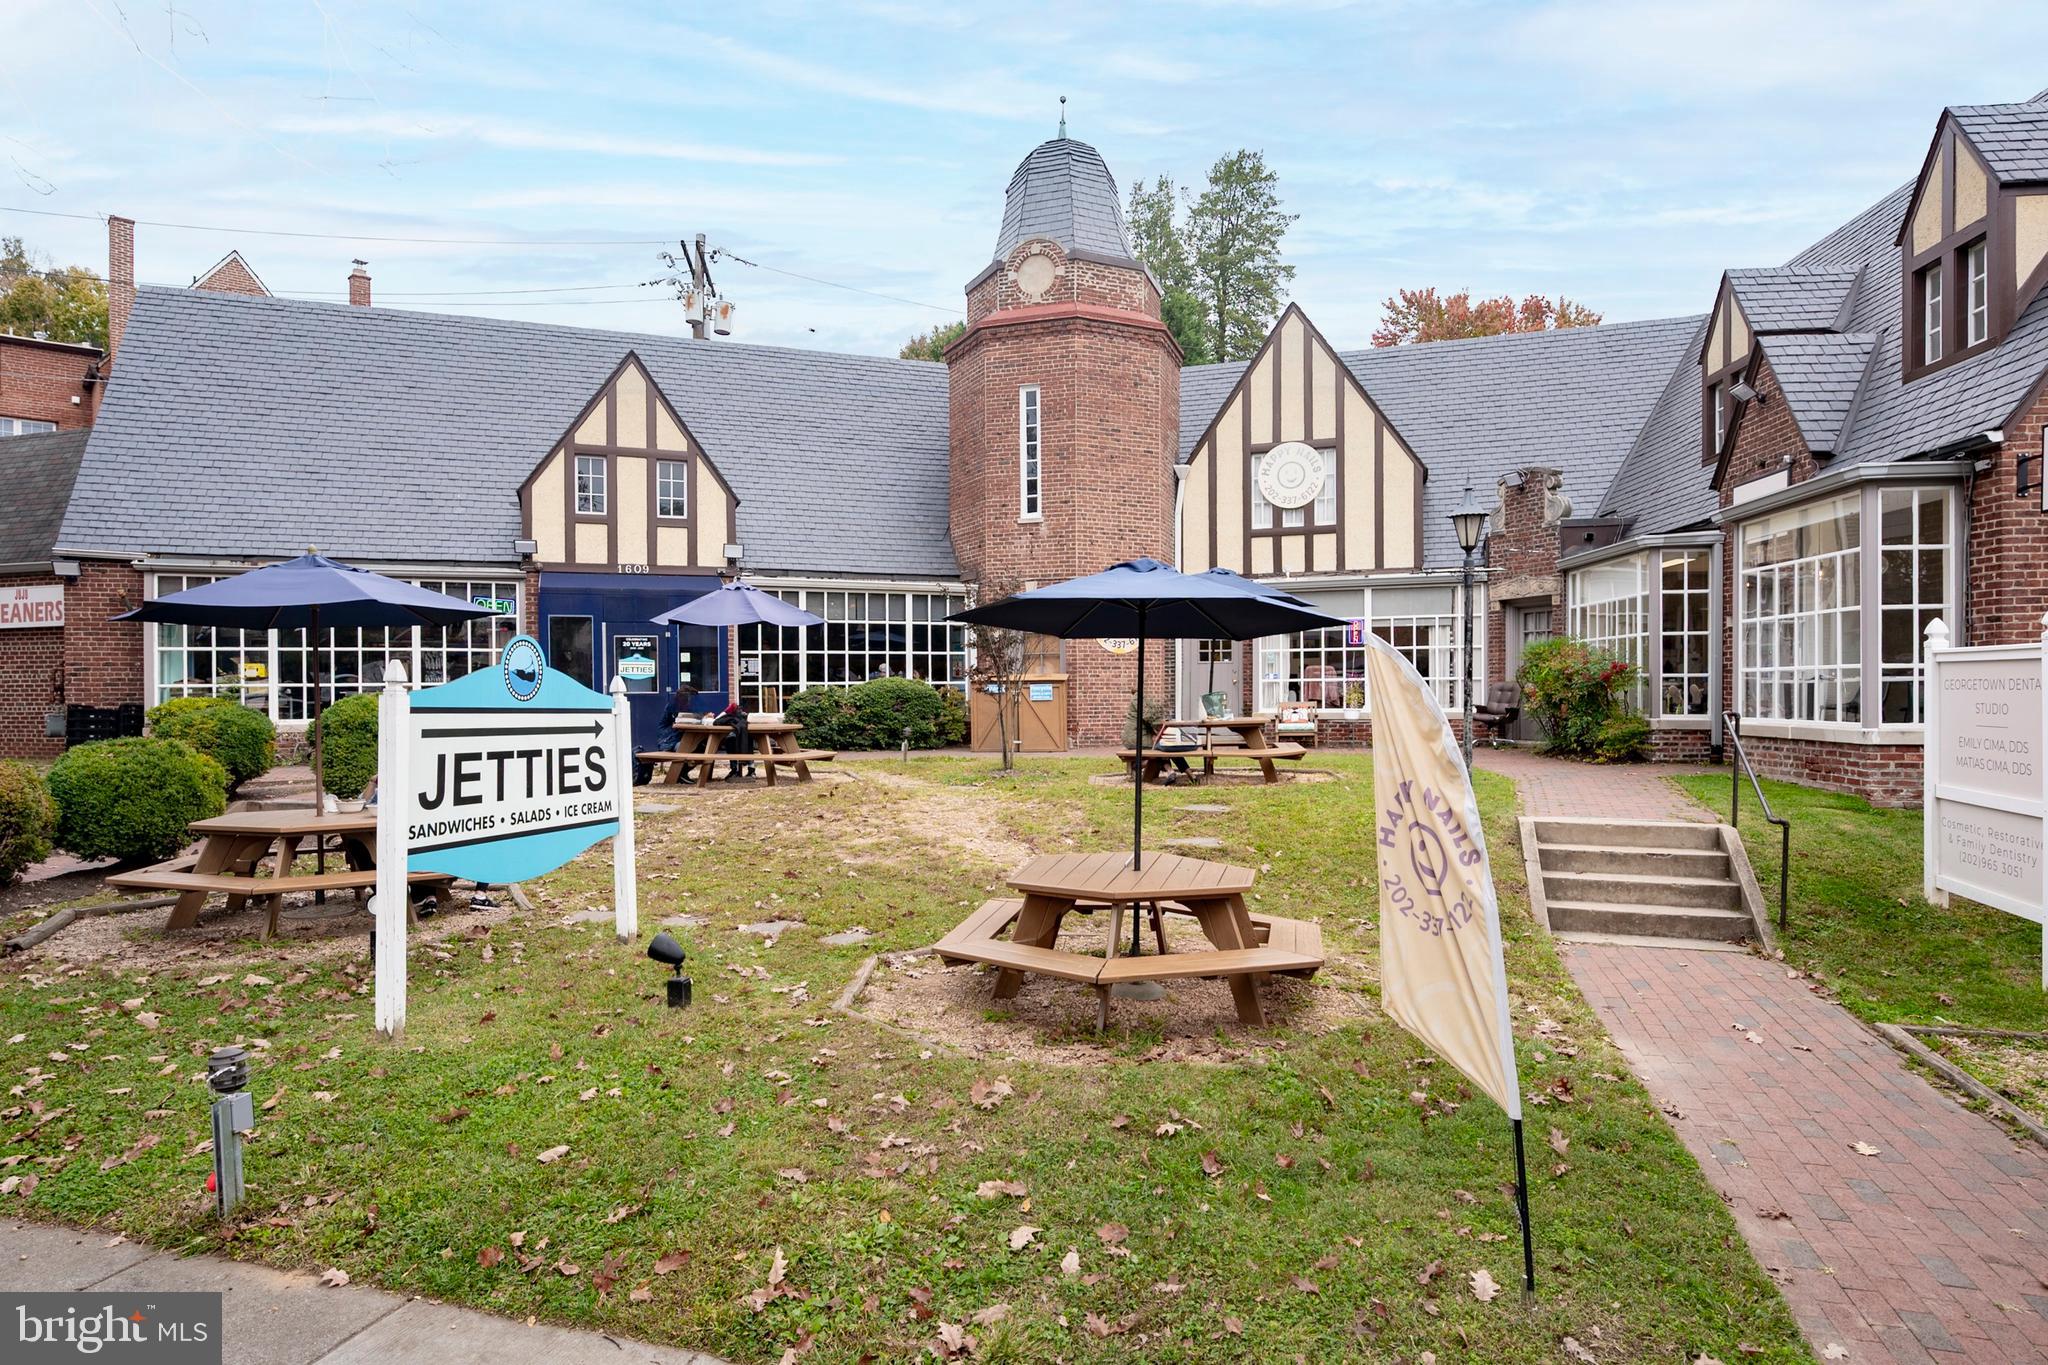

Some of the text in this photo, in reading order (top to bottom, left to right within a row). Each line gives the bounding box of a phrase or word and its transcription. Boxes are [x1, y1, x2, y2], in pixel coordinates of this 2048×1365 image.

[1261, 447, 1322, 477] HAPPY NAILS
[617, 564, 649, 574] 1609
[0, 600, 62, 623] EANERS
[476, 600, 512, 613] OPEN
[1944, 678, 2006, 691] GEORGETOWN
[1975, 702, 2009, 715] STUDIO
[1958, 736, 2030, 754] EMILY CIMA, DDS
[1956, 756, 2032, 776] MATIAS CIMA, DDS
[418, 746, 607, 810] JETTIES
[408, 800, 612, 840] SANDWICHES SALADS ICE CREAM
[1424, 787, 1482, 868] NAILS
[1941, 816, 1984, 838] Cosmetic,
[1948, 833, 2038, 868] & Family Dentistry
[1959, 851, 2024, 878] (202)965 3051
